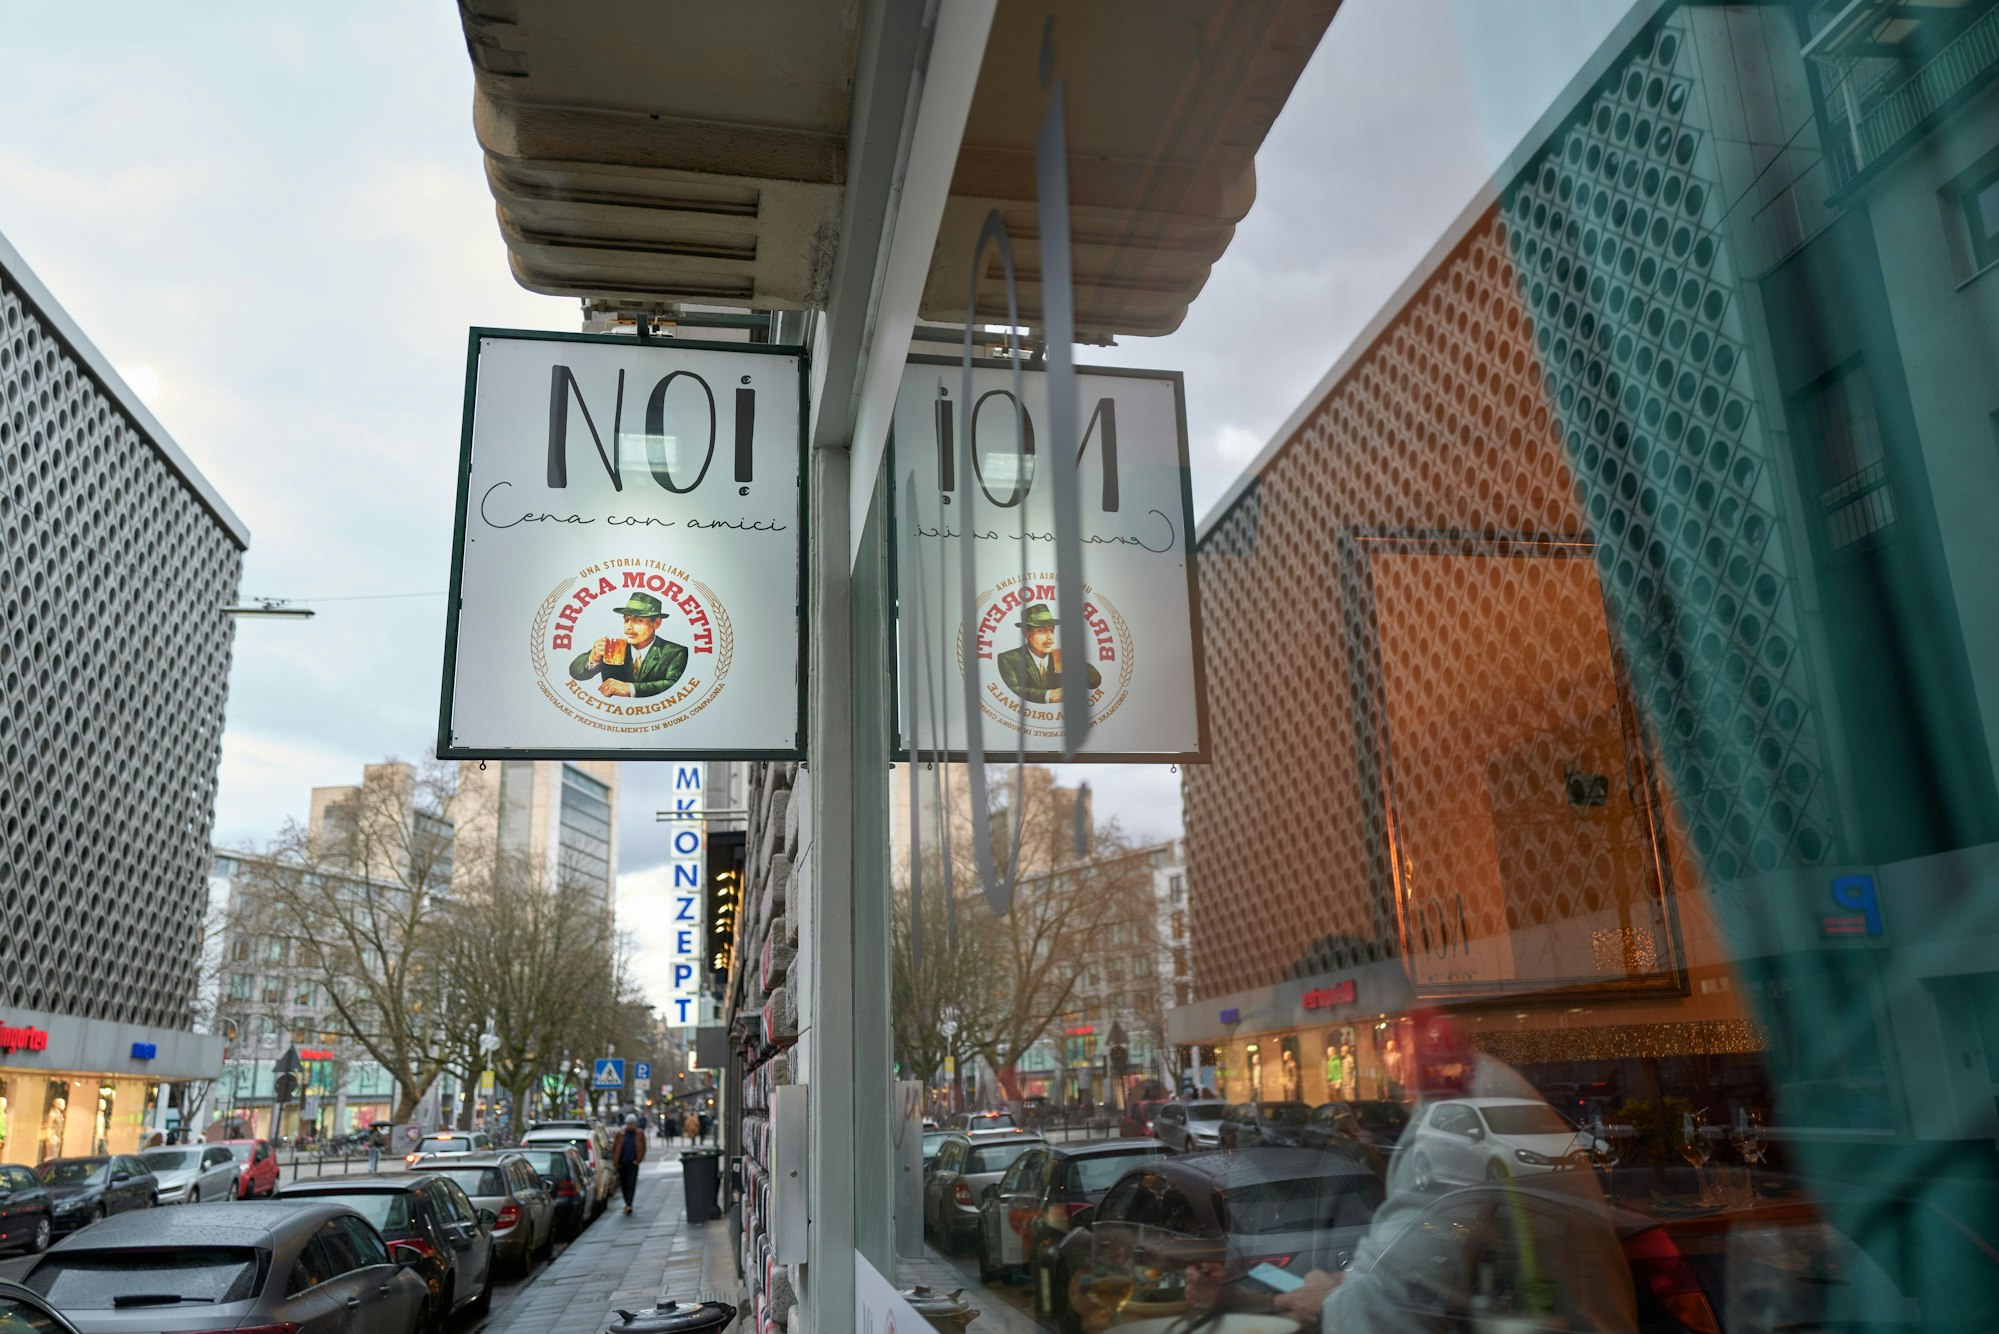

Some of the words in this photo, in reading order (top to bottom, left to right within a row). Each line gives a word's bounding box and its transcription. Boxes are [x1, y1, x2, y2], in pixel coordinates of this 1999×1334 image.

[481, 481, 596, 529] Cena
[607, 513, 676, 527] con
[687, 516, 787, 531] amici
[579, 564, 601, 578] UNA
[603, 558, 641, 570] STORIA
[645, 559, 691, 583] ITALIANA
[552, 577, 618, 650] BIRRA
[622, 572, 713, 654] MORETTI
[537, 680, 574, 718] CONSUMARE
[573, 714, 649, 734] PREFERIBILMENTE
[651, 724, 660, 732] IN
[663, 714, 690, 729] BUONA
[689, 682, 725, 717] COMPAGNIA
[565, 679, 624, 716] RICETTA
[625, 677, 701, 716] ORIGINALE
